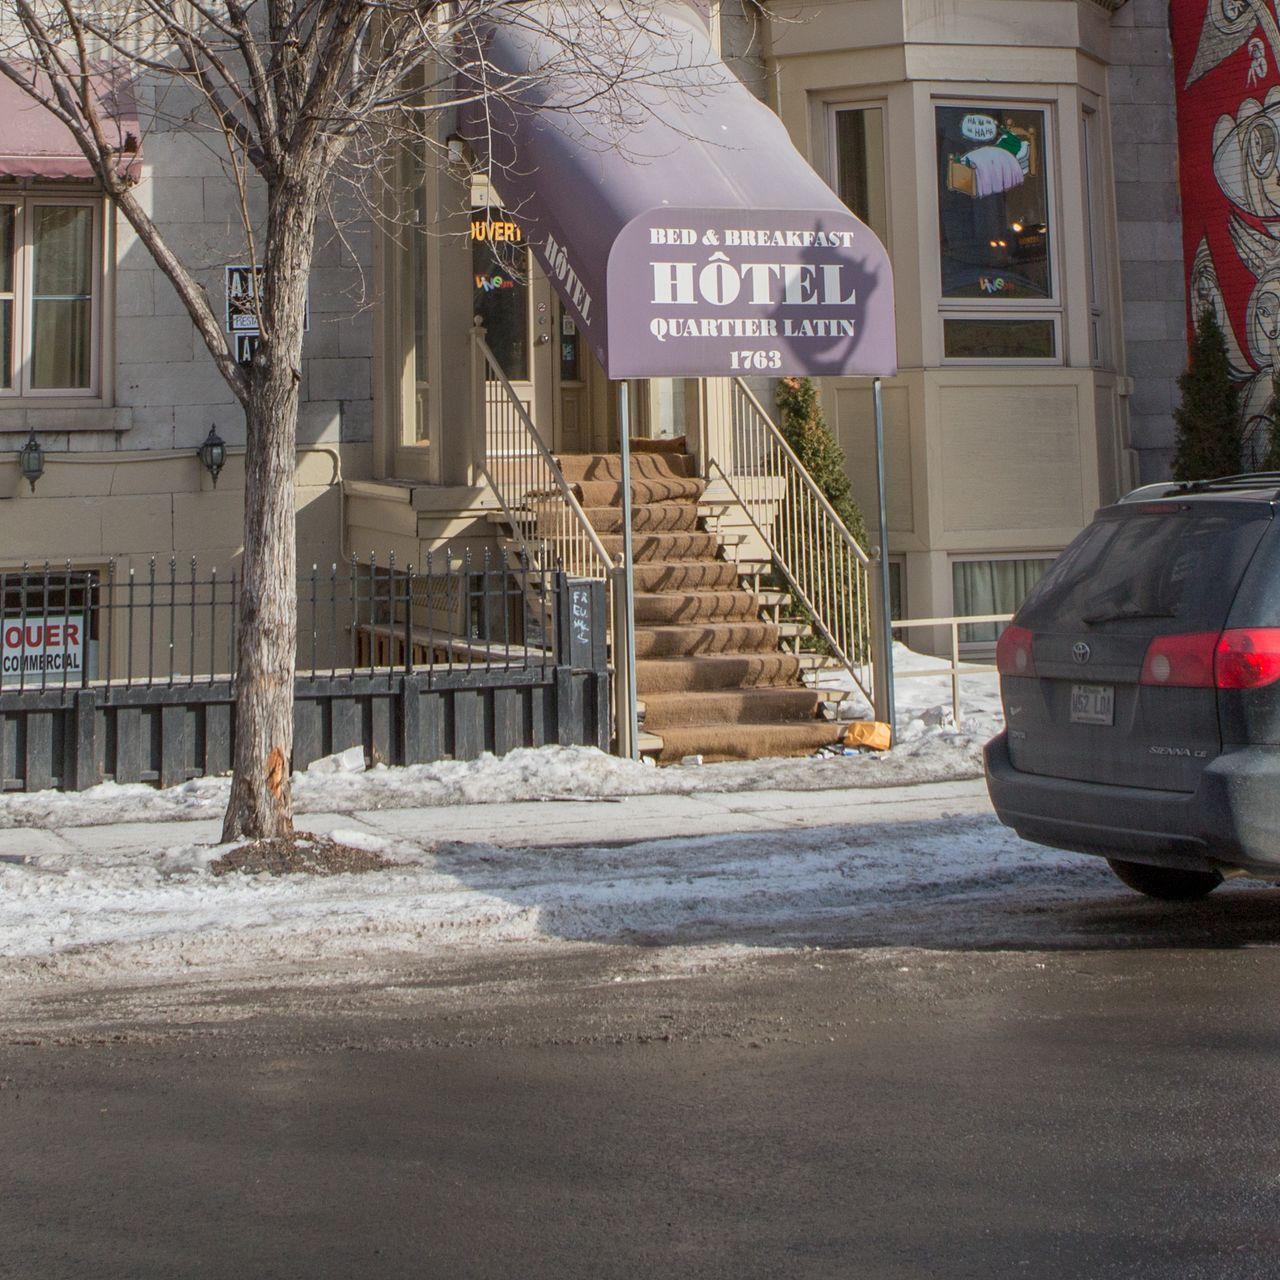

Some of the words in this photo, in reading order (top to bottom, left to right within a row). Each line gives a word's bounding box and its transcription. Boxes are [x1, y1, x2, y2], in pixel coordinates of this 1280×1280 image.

[649, 228, 697, 245] BED
[702, 229, 719, 246] &
[724, 228, 854, 247] BREAKFAST
[544, 231, 593, 327] HÔTEL
[649, 251, 856, 305] HÔTEL
[650, 318, 778, 341] QUARTIER
[783, 319, 855, 336] LATIN
[730, 350, 782, 369] 1763
[3, 653, 80, 673] COMMERCIAL
[1148, 745, 1192, 757] SIENNA
